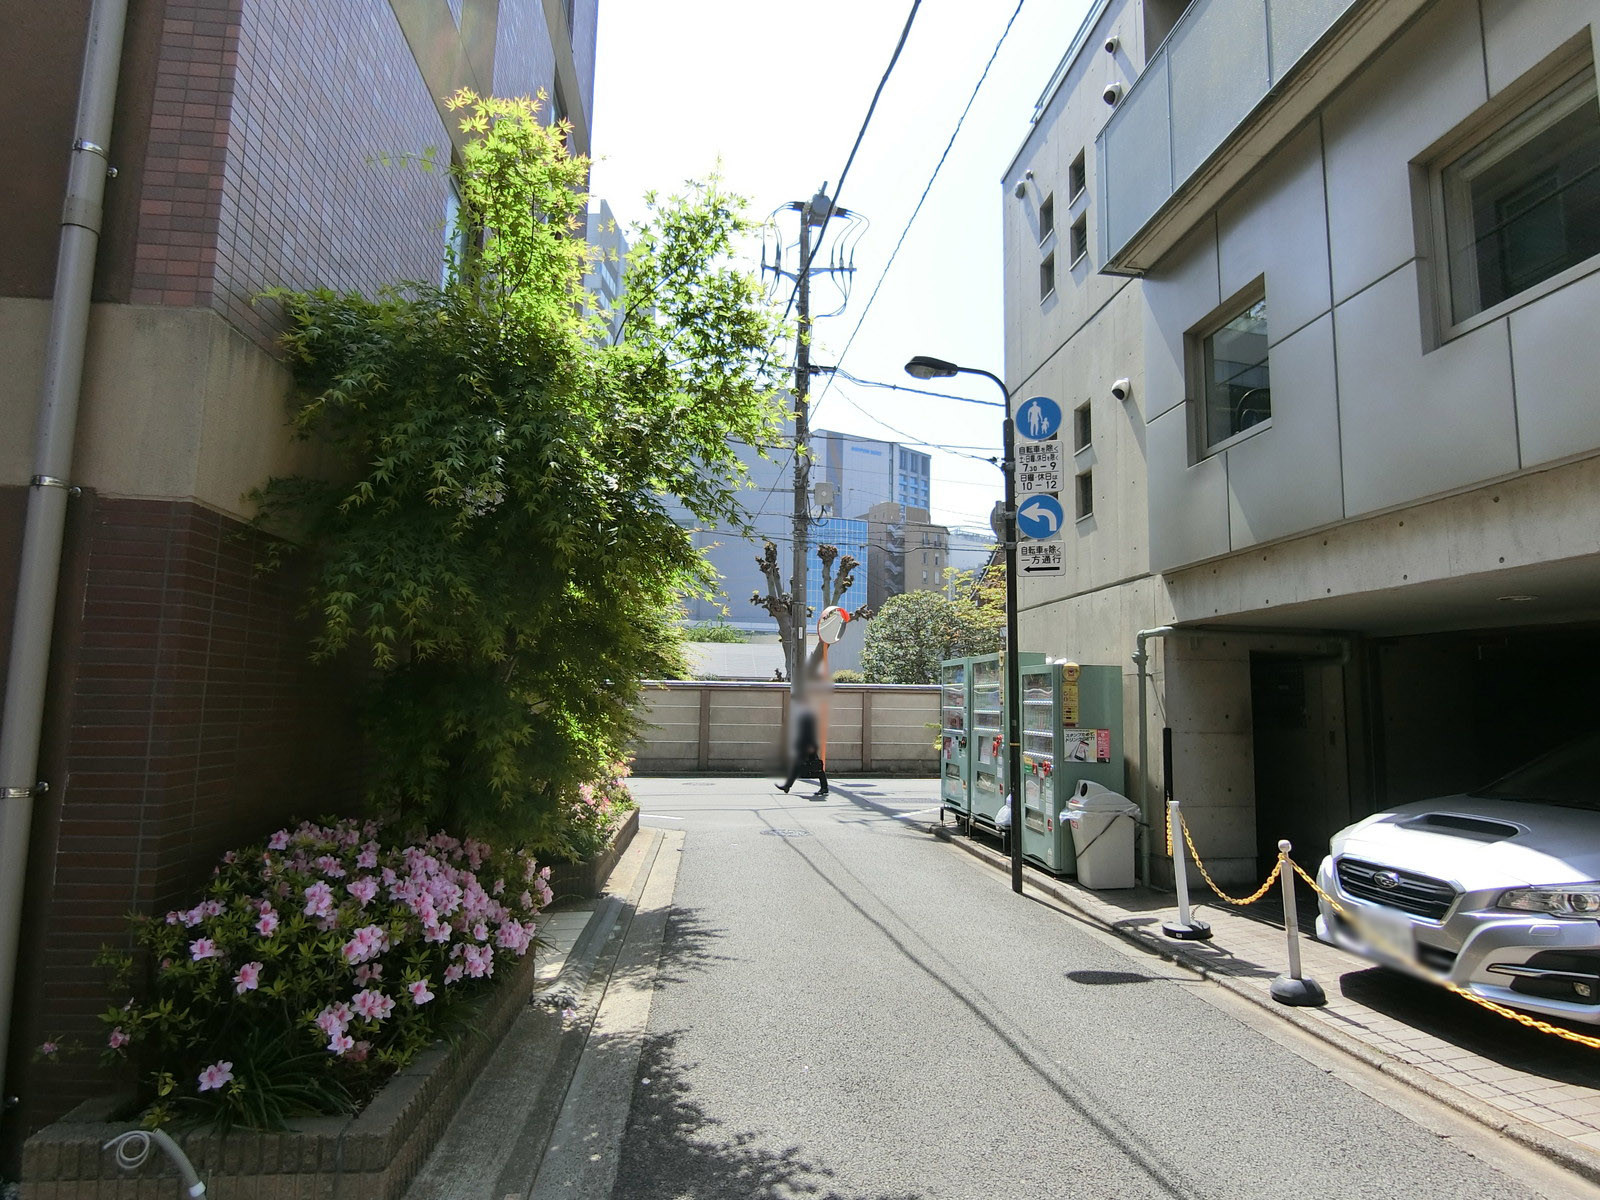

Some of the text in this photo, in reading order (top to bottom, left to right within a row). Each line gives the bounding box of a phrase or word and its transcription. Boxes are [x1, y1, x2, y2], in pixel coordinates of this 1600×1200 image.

[1019, 444, 1059, 454] 自転車を除く
[1021, 545, 1061, 555] 自転車を除く
[1021, 555, 1061, 564] 一方通行
